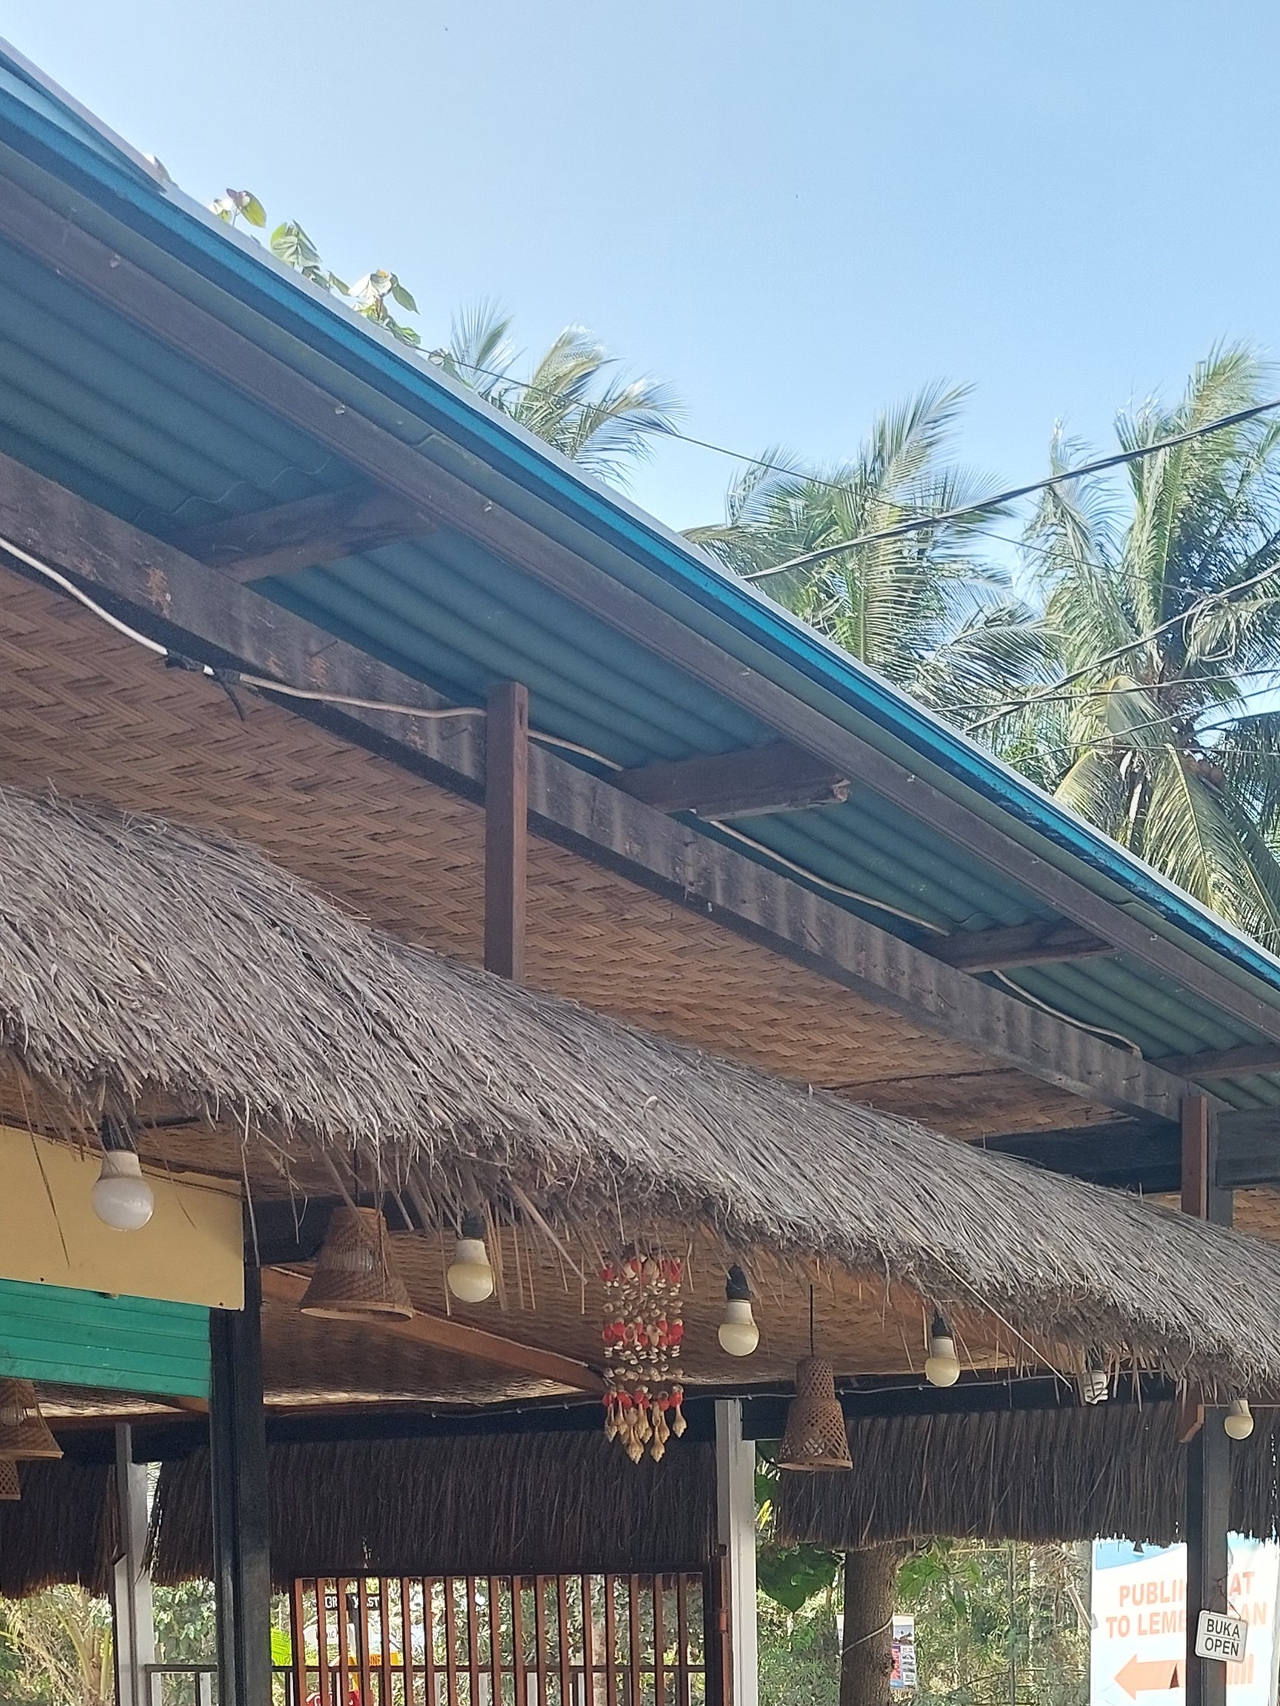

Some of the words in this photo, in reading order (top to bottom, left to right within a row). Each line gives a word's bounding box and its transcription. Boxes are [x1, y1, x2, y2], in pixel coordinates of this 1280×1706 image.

[1106, 1615, 1131, 1638] TO
[1206, 1617, 1241, 1639] BUKA
[1204, 1636, 1240, 1657] OPEN
